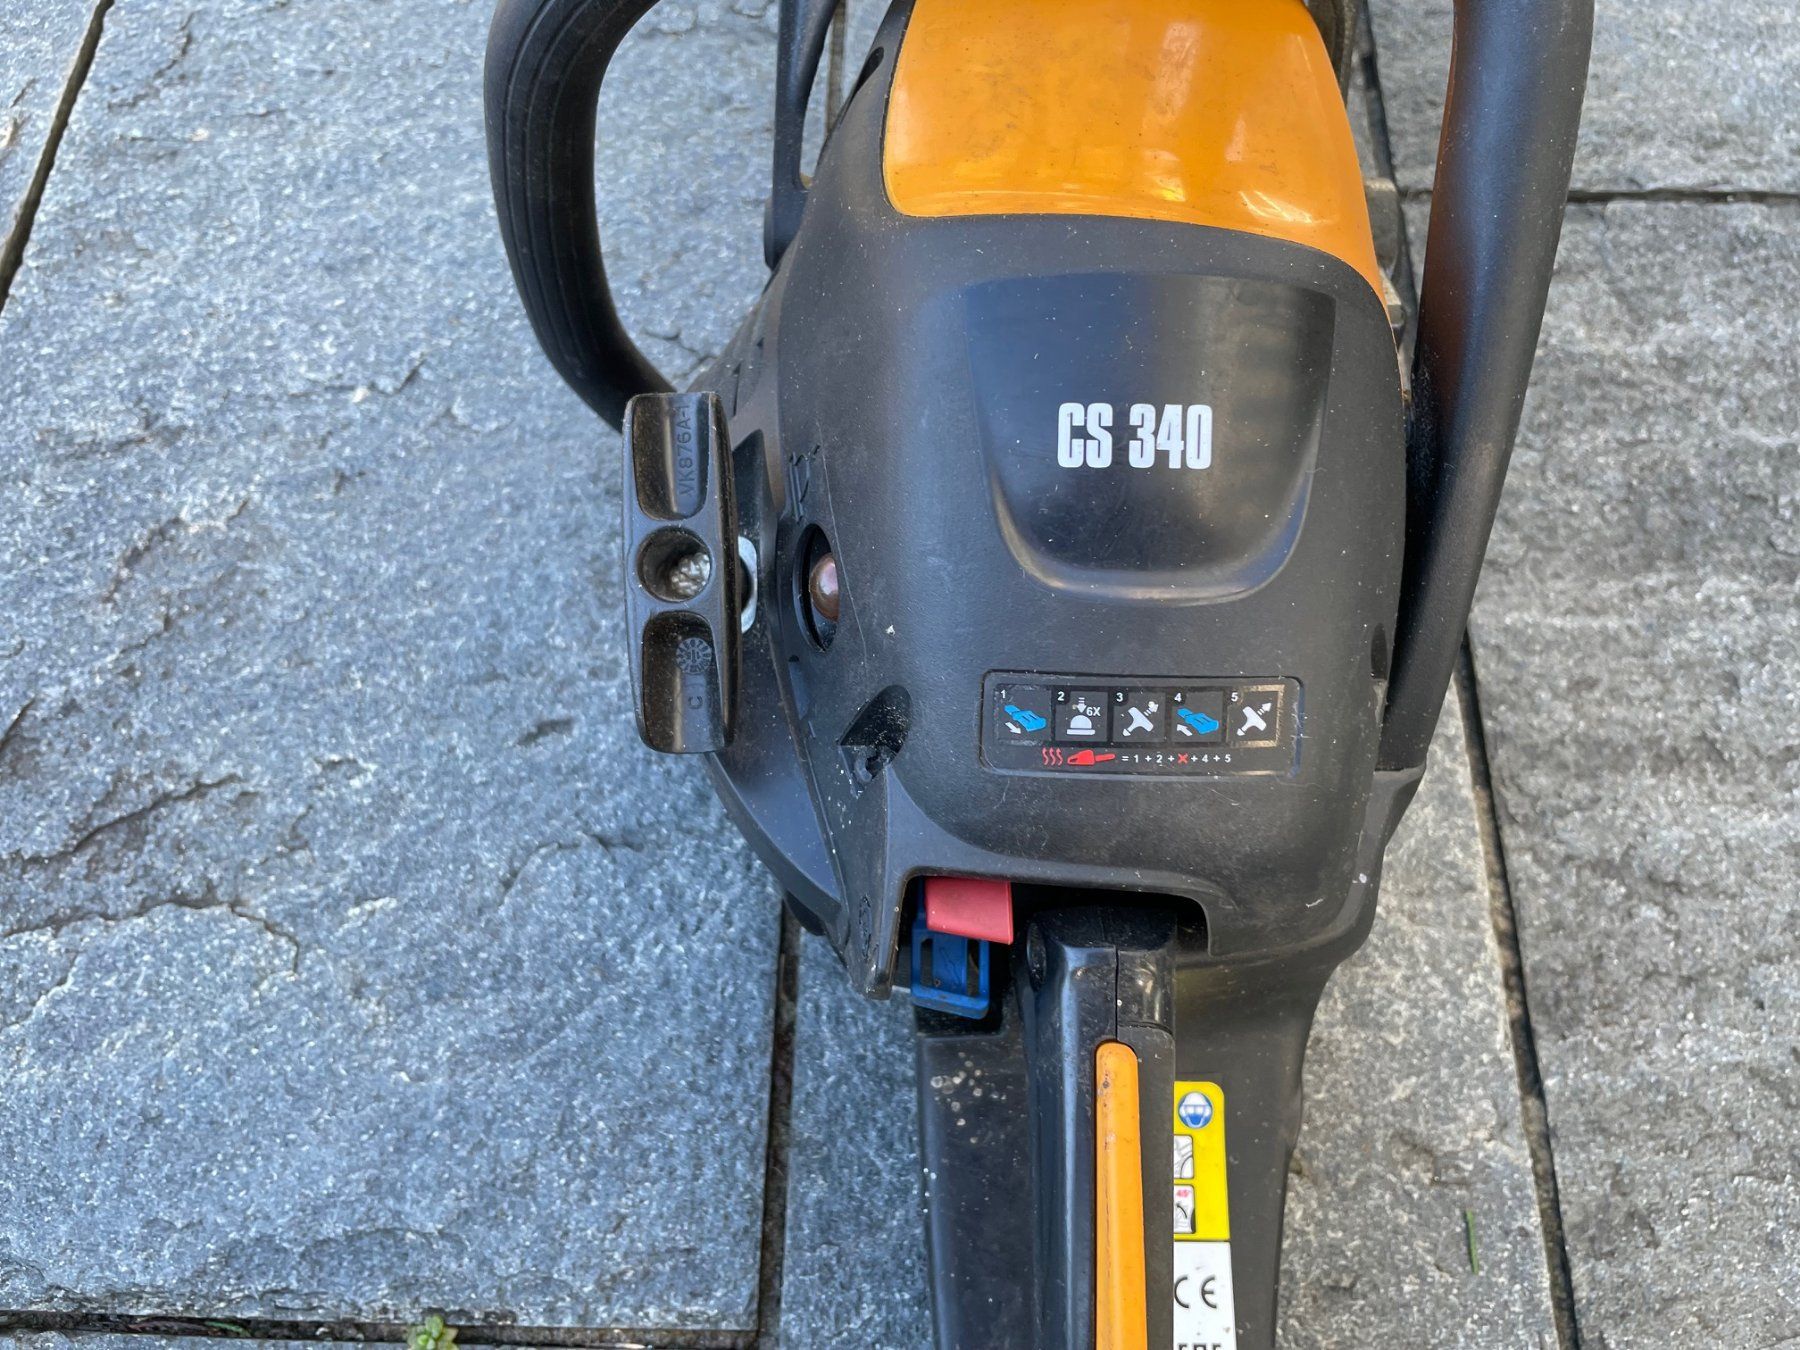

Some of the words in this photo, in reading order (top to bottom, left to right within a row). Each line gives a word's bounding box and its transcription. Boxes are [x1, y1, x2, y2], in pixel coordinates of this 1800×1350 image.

[1057, 402, 1114, 469] CS
[1128, 403, 1213, 470] 340
[1000, 689, 1007, 699] 1
[1057, 691, 1065, 701] 2
[1116, 692, 1124, 702] 3
[1174, 692, 1182, 702] 4
[1230, 692, 1239, 702] 5
[1086, 706, 1101, 717] 6X
[1156, 754, 1163, 763] 2
[1201, 754, 1209, 763] 4
[1224, 754, 1231, 763] 5
[1174, 1276, 1218, 1309] CE
